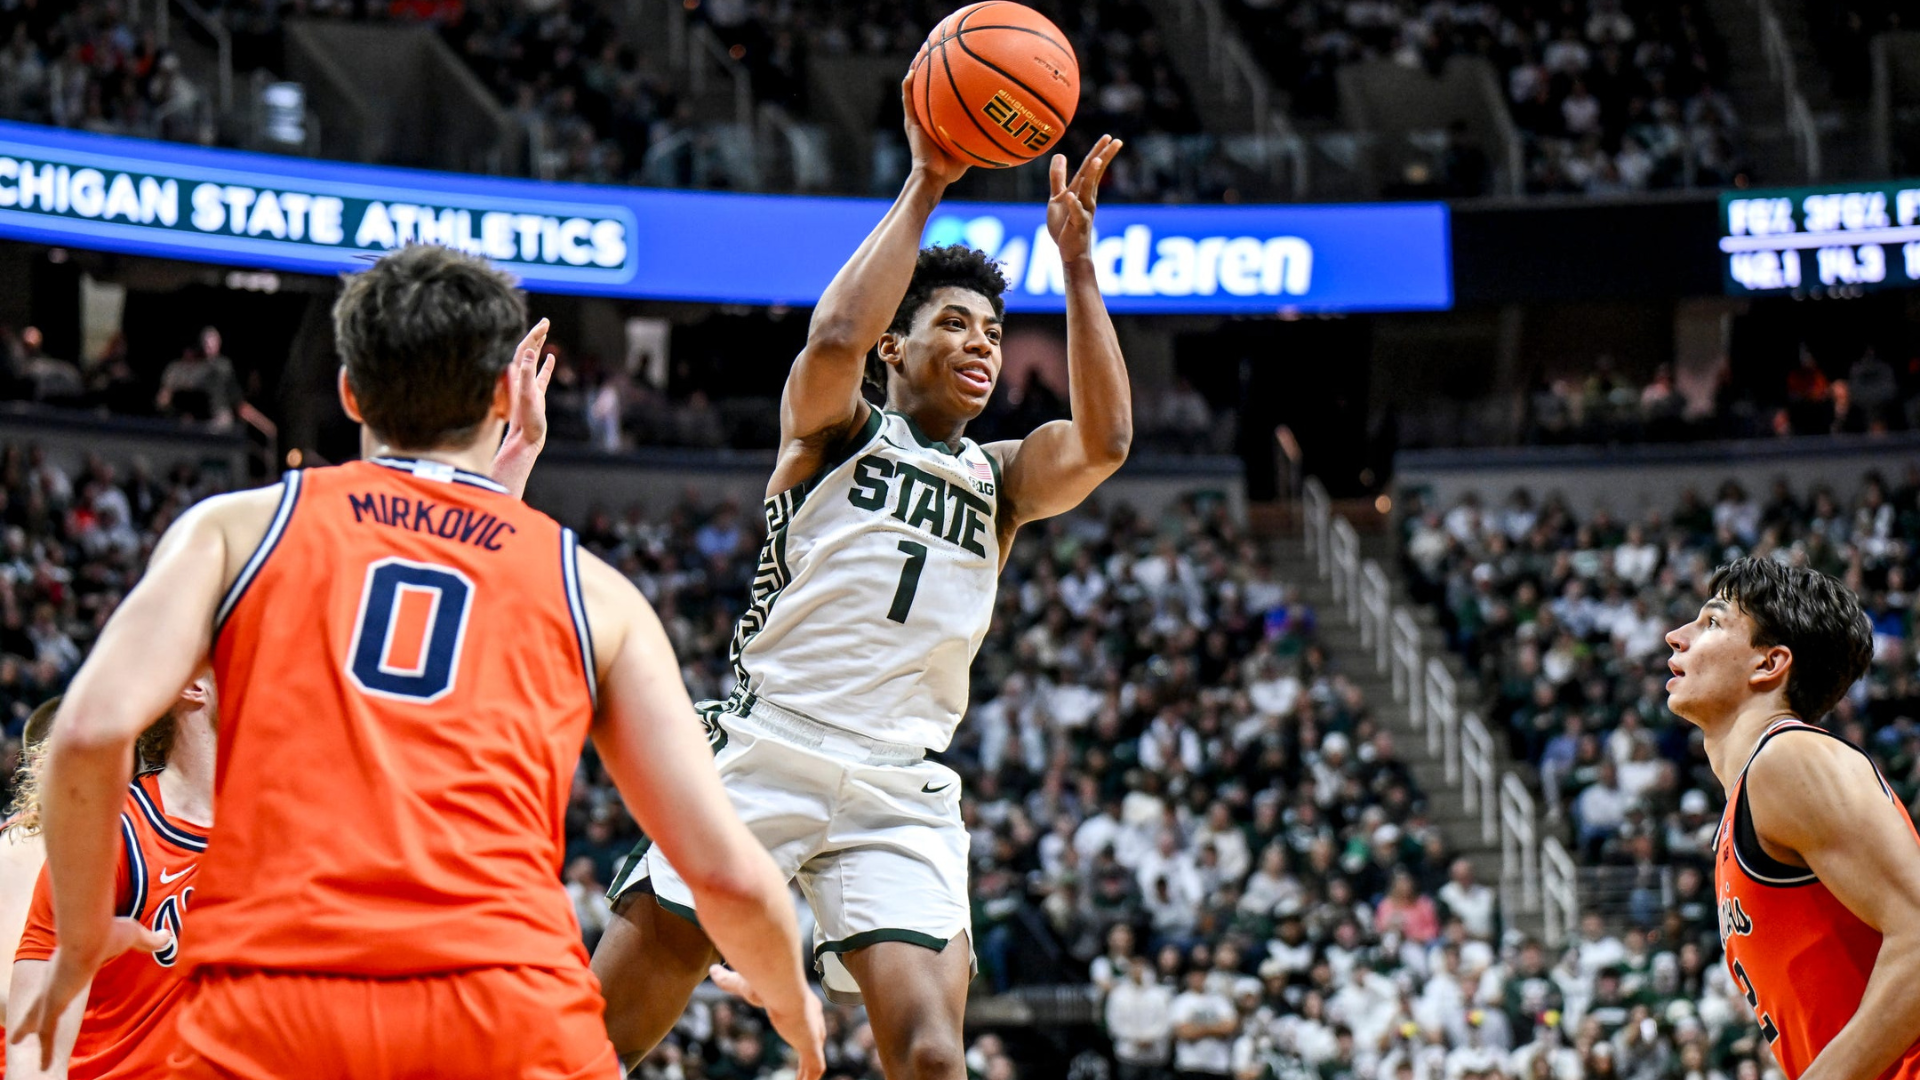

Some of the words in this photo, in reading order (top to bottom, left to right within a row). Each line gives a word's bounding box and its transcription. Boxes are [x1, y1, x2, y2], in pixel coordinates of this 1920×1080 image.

[981, 94, 1052, 152] ELITE
[191, 181, 344, 245] STATE
[355, 201, 627, 267] ATHLETICS
[1025, 223, 1313, 296] McLaren
[348, 493, 515, 551] MIRKOVIC
[848, 454, 992, 559] STATE
[886, 540, 928, 624] 1
[344, 556, 476, 705] 0
